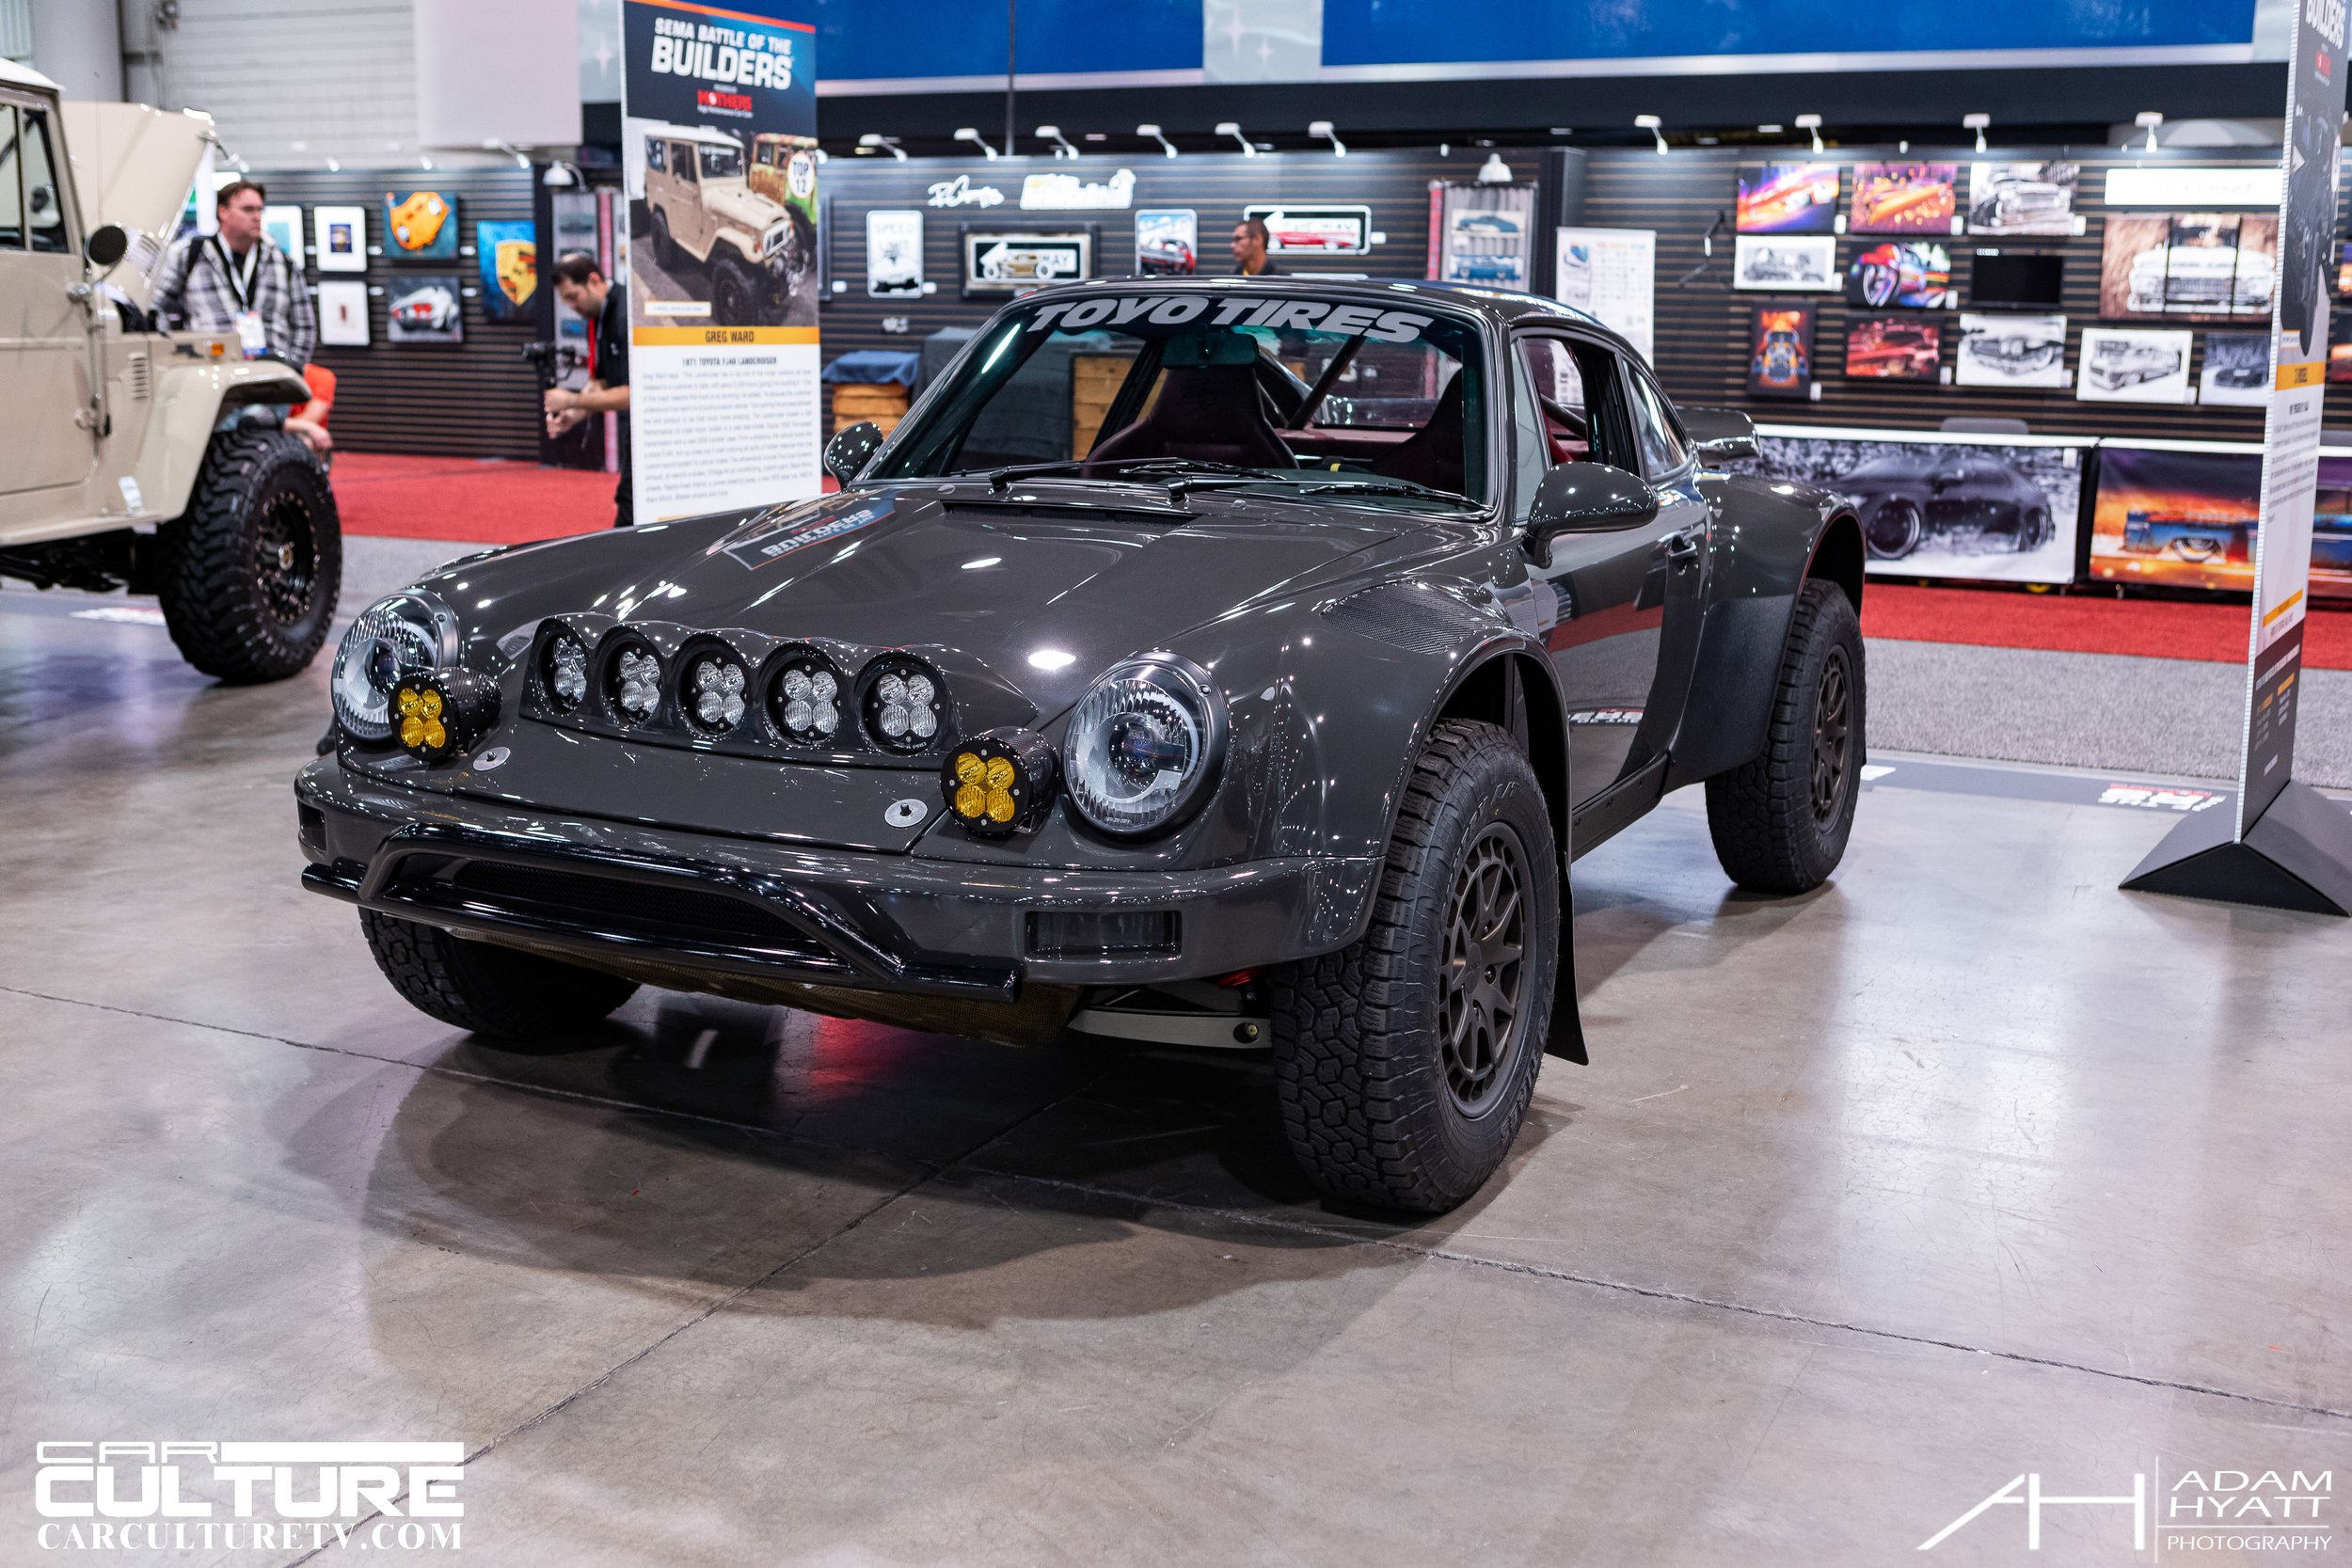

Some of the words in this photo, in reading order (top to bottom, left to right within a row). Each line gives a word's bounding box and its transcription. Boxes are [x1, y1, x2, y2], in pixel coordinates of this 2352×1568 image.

[655, 17, 695, 40] SEMA
[697, 24, 746, 48] BATTLE
[747, 33, 766, 51] OF
[768, 36, 792, 55] THE
[651, 35, 792, 90] BUILDERS
[793, 161, 809, 177] TOP
[796, 179, 806, 193] 12
[1026, 296, 1211, 333] TOYO
[1211, 297, 1434, 343] TIRES
[705, 330, 727, 343] GREG
[730, 330, 755, 342] WARD
[698, 356, 721, 366] TOYOTA
